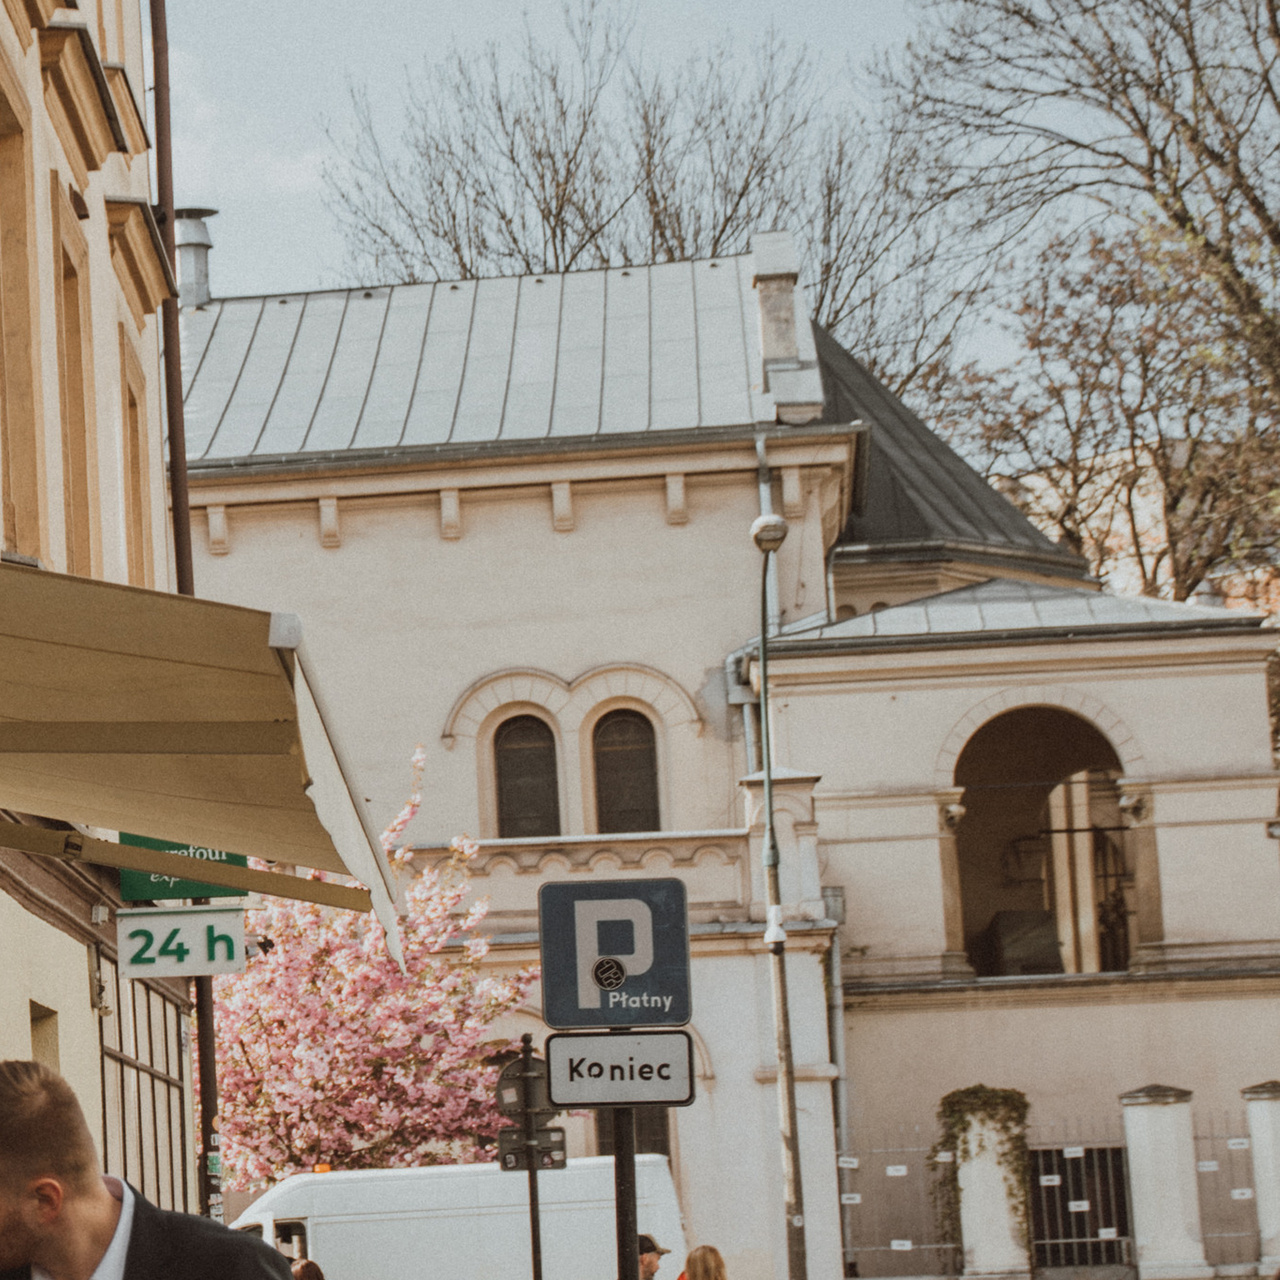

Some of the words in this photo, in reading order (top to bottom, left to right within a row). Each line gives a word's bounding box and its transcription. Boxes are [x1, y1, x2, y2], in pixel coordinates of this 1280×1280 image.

[127, 928, 190, 965] 24
[206, 924, 235, 962] h
[574, 898, 654, 1009] P
[608, 991, 673, 1012] Płatny
[568, 1056, 671, 1082] Koniec
